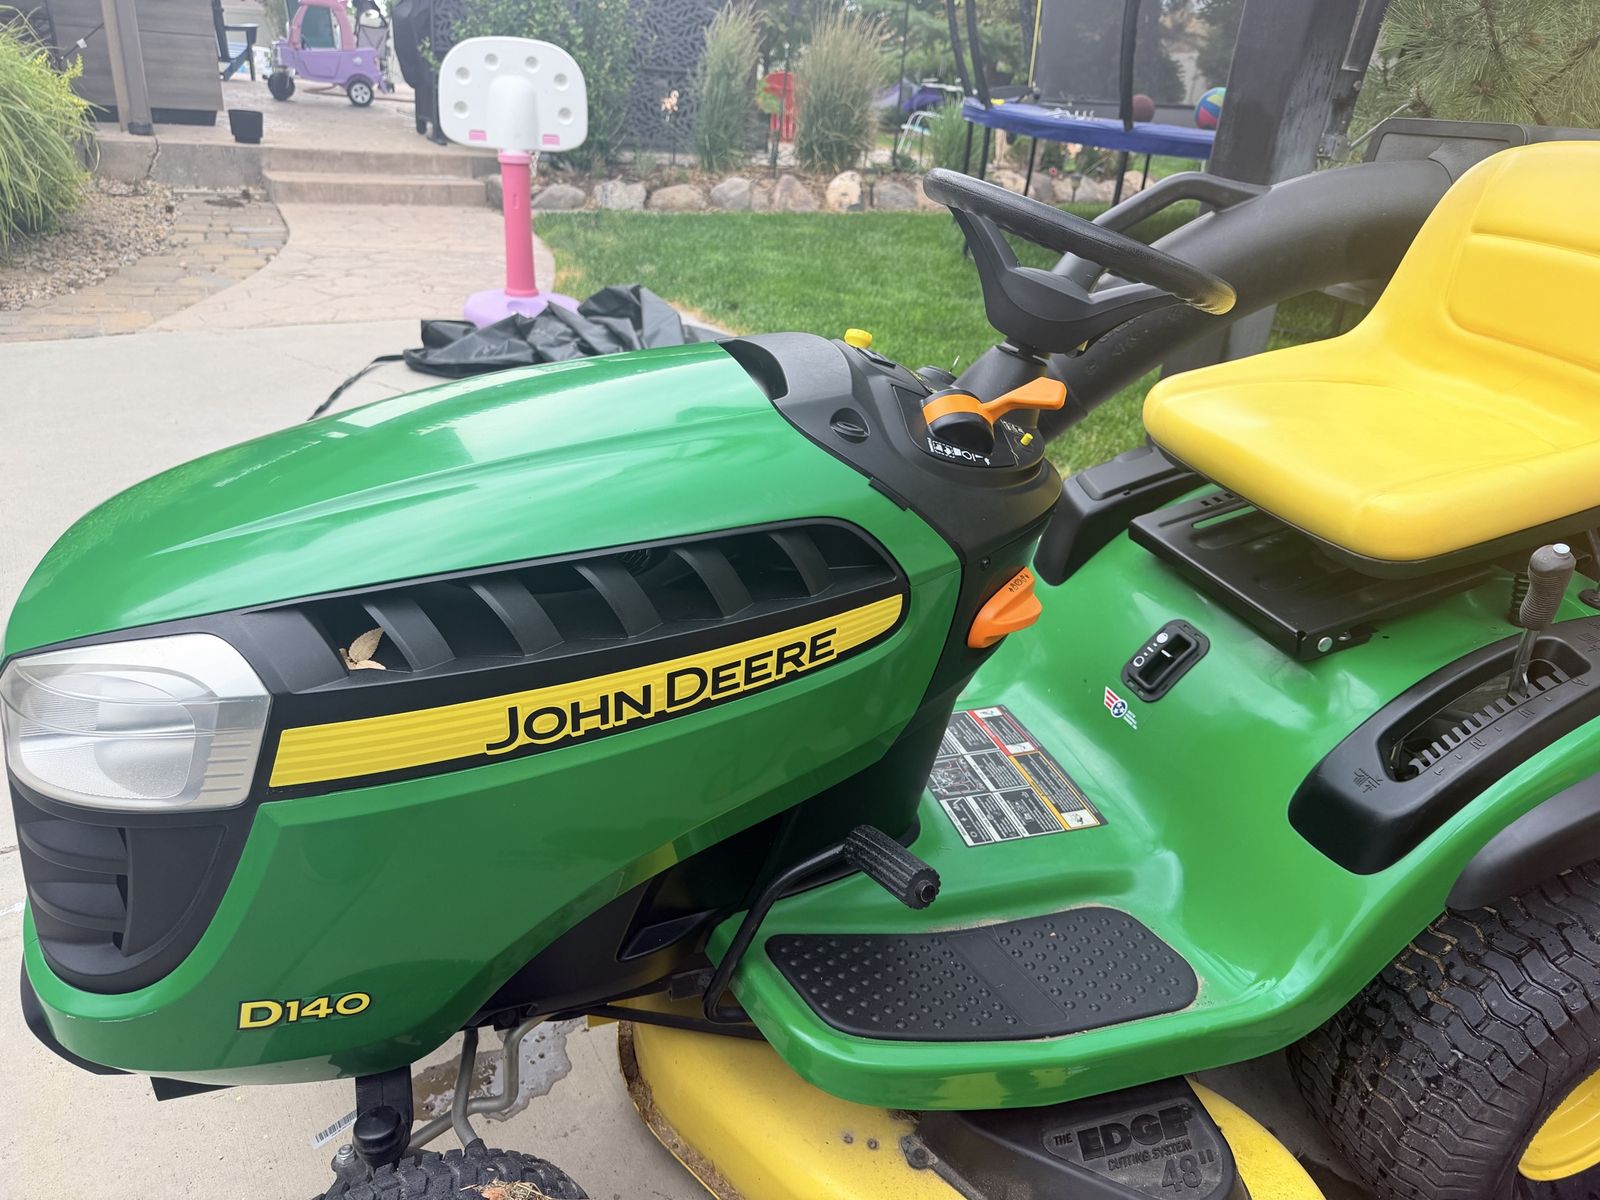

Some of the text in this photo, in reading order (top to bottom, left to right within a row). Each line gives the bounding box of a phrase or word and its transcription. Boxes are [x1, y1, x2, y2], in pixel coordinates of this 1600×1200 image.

[485, 627, 837, 752] JOHN DEERE
[237, 992, 372, 1030] D140
[1053, 1105, 1190, 1162] THE EDGE
[1107, 1138, 1193, 1171] CUTTING SYSTEM
